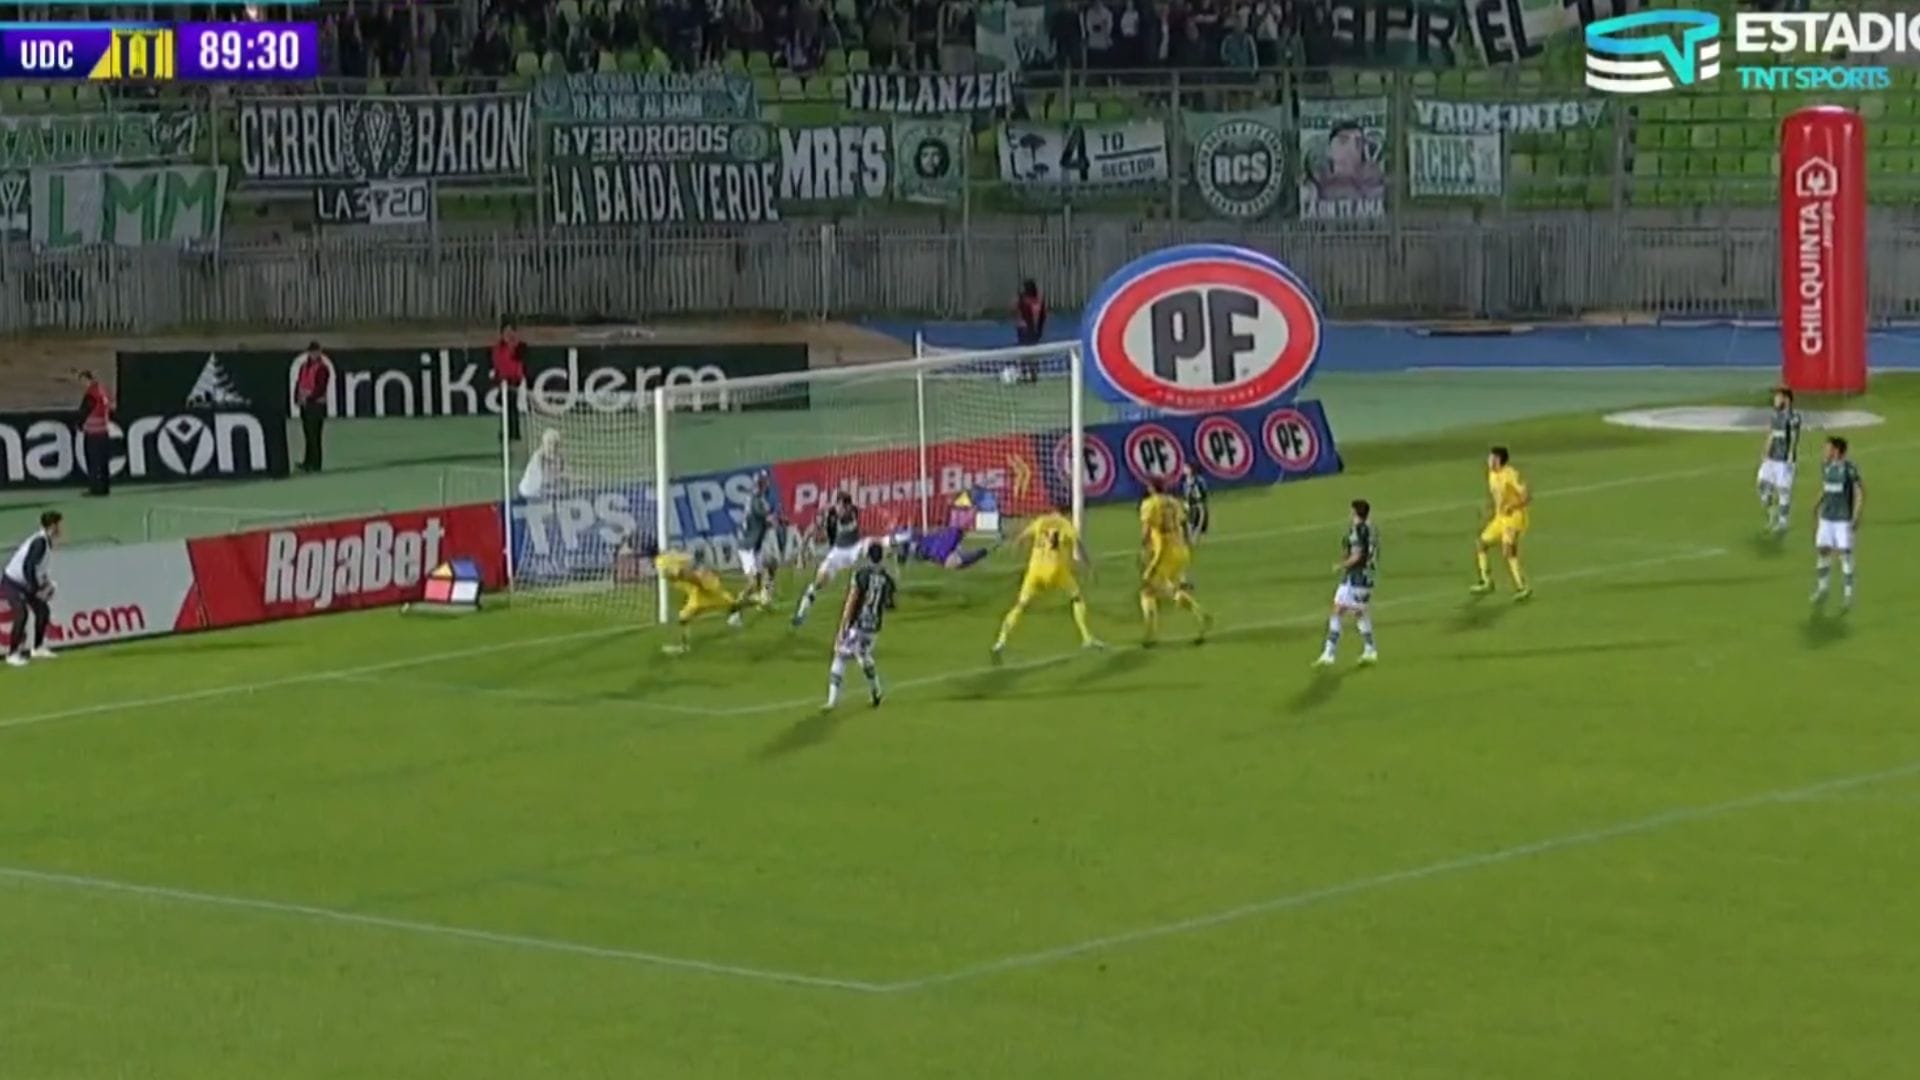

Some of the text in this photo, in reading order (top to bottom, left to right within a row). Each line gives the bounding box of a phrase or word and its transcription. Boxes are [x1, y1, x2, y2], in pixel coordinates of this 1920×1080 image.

[240, 104, 342, 177] CERRO
[416, 98, 524, 175] BARON
[1059, 124, 1090, 181] 4
[1101, 157, 1155, 178] SECTOR
[1214, 152, 1268, 185] RCS
[552, 162, 780, 225] LA BANDA VERDE
[1799, 202, 1822, 356] CHILQUINTA
[1138, 438, 1169, 472] PF
[1208, 429, 1239, 466] PF
[1274, 421, 1303, 457] PF
[941, 464, 1006, 494] Bus
[512, 493, 638, 556] TPS
[264, 516, 444, 609] RojaBet
